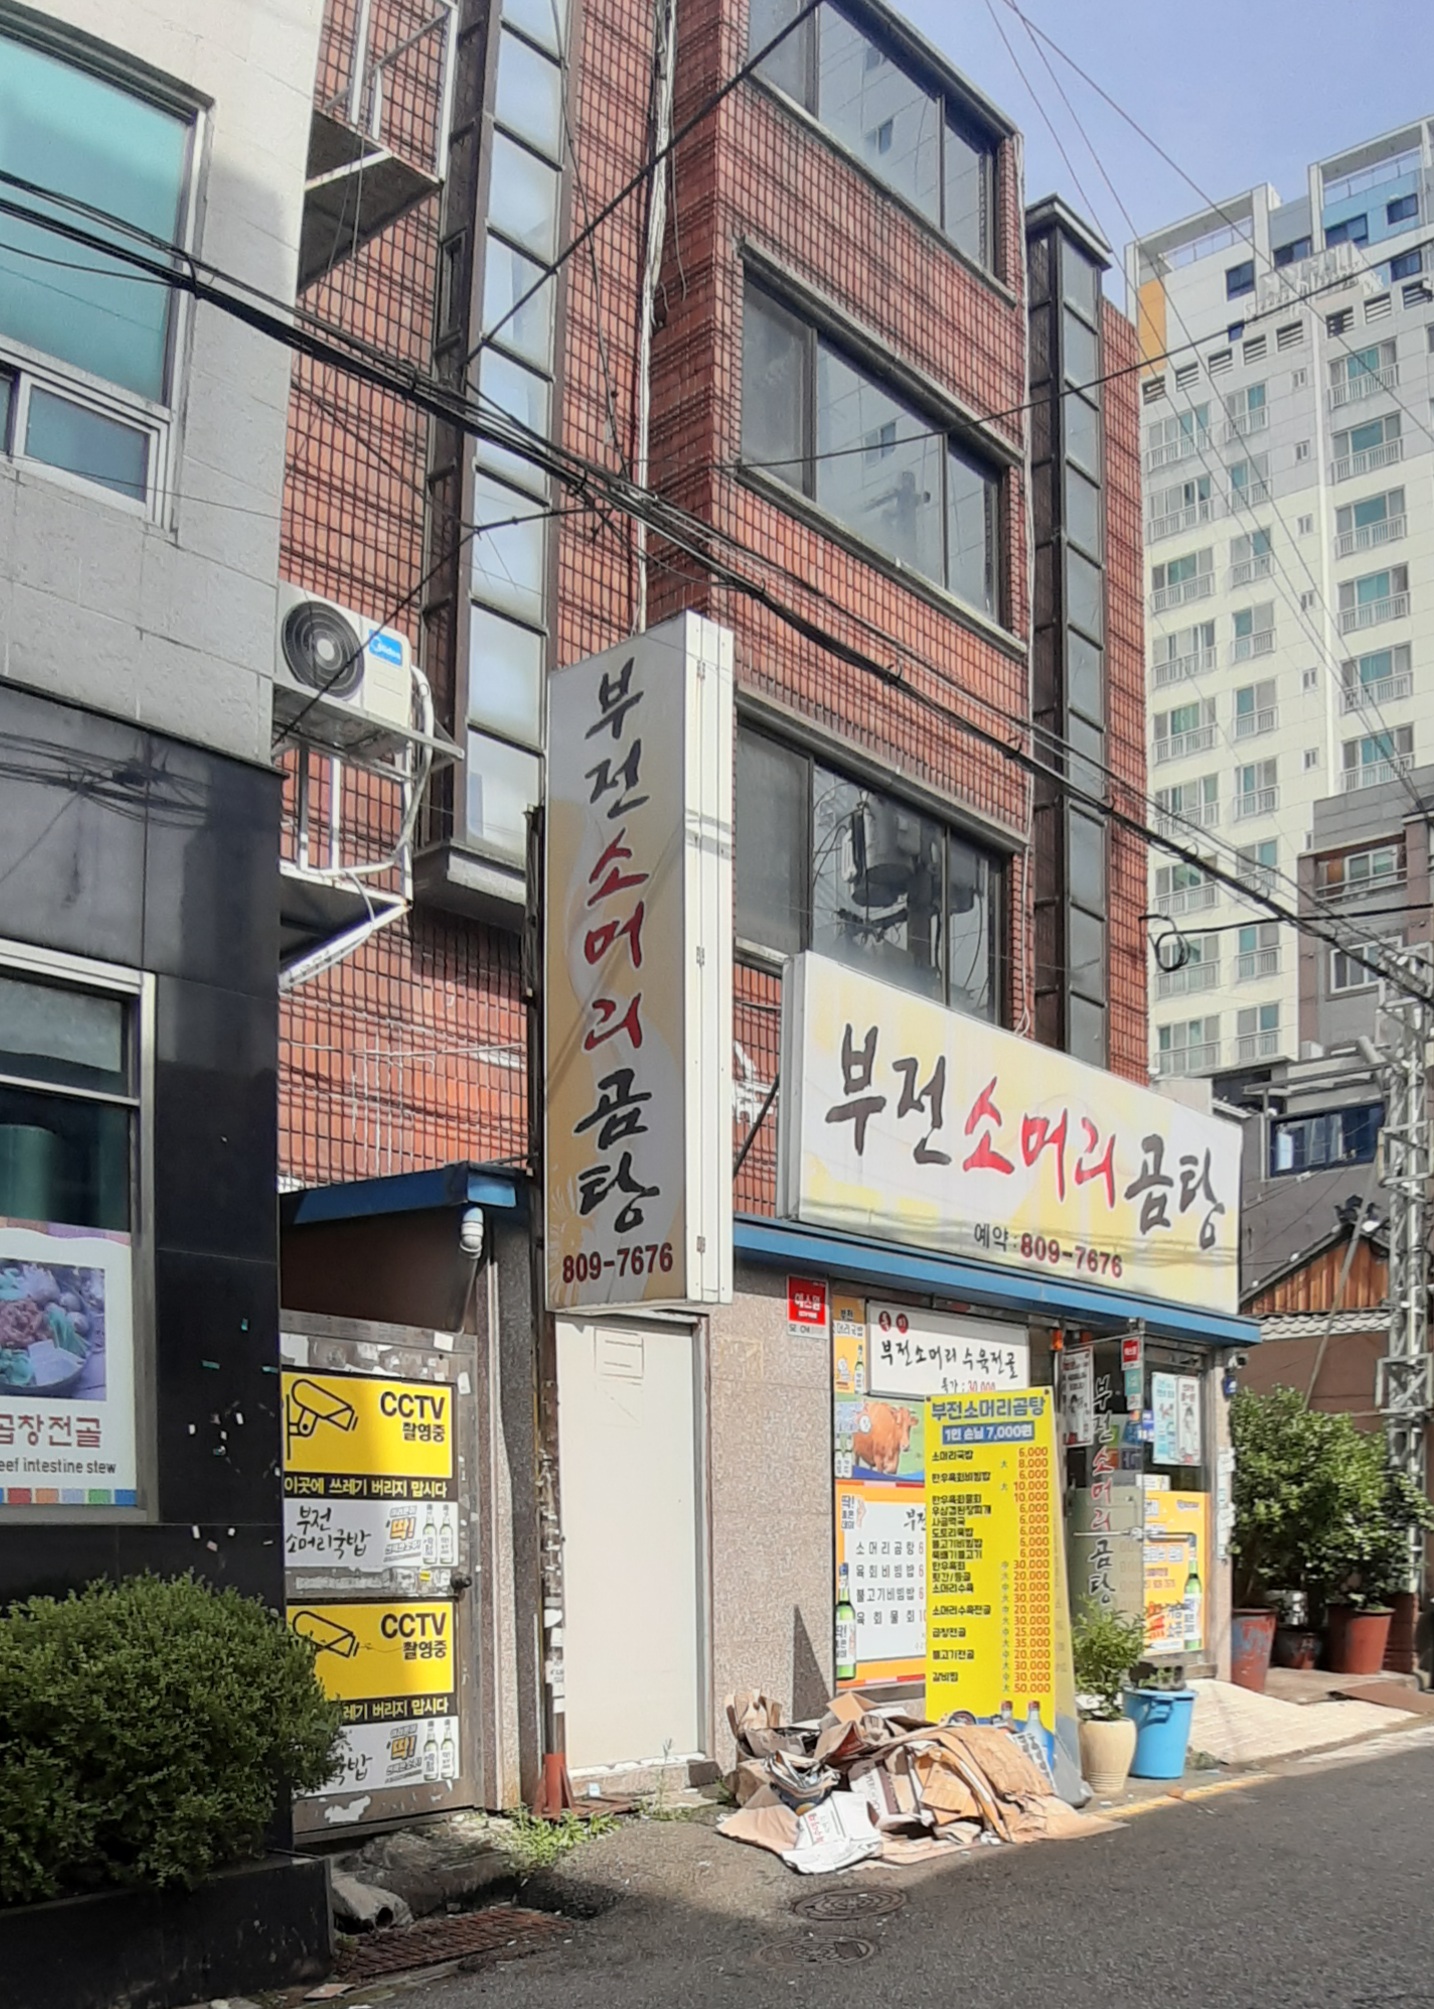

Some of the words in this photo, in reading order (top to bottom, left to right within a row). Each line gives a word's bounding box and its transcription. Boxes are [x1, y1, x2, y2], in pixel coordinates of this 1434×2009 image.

[1020, 1233, 1123, 1279] 809-7676
[562, 1241, 674, 1284] 809-7676
[967, 1380, 996, 1392] 30000
[380, 1391, 446, 1420] CCTV
[932, 1396, 1046, 1421] 부전소머리곰탕
[402, 1423, 446, 1443] 촬영중
[944, 1429, 962, 1442] 1인
[964, 1427, 984, 1441] 손님
[1019, 1447, 1048, 1458] 6,000
[0, 1456, 19, 1473] eef
[23, 1456, 83, 1474] intestine
[86, 1459, 117, 1475] stew
[1019, 1458, 1048, 1469] 8,000
[1019, 1469, 1048, 1480] 6,000
[284, 1477, 324, 1495] 이곳에
[329, 1477, 367, 1496] 쓰레기
[371, 1478, 407, 1497] 버리지
[411, 1480, 447, 1499] 맙시다
[1014, 1481, 1048, 1492] 10,000
[1014, 1492, 1048, 1503] 10,000
[1020, 1503, 1049, 1514] 6,000
[296, 1505, 332, 1536] 부전
[1020, 1514, 1049, 1525] 6,000
[1020, 1525, 1049, 1536] 6,000
[286, 1529, 372, 1560] 소머리국밥
[1020, 1536, 1049, 1547] 6,000
[1020, 1547, 1049, 1558] 6,000
[1014, 1559, 1049, 1570] 30,000
[1014, 1570, 1049, 1581] 20,000
[1014, 1582, 1050, 1592] 20,000
[1014, 1593, 1050, 1604] 30,000
[1014, 1604, 1050, 1615] 20,000
[381, 1612, 447, 1640] CCTV
[1014, 1615, 1050, 1626] 30,000
[1014, 1626, 1050, 1637] 25,000
[1014, 1638, 1050, 1648] 35,000
[403, 1640, 447, 1660] 촬영중
[1014, 1649, 1050, 1660] 20,000
[1014, 1660, 1050, 1671] 30,000
[1014, 1671, 1051, 1682] 30,000
[1014, 1683, 1051, 1693] 50,000
[343, 1703, 368, 1721] 레기
[372, 1700, 408, 1719] 버리지
[412, 1697, 449, 1716] 맙시다
